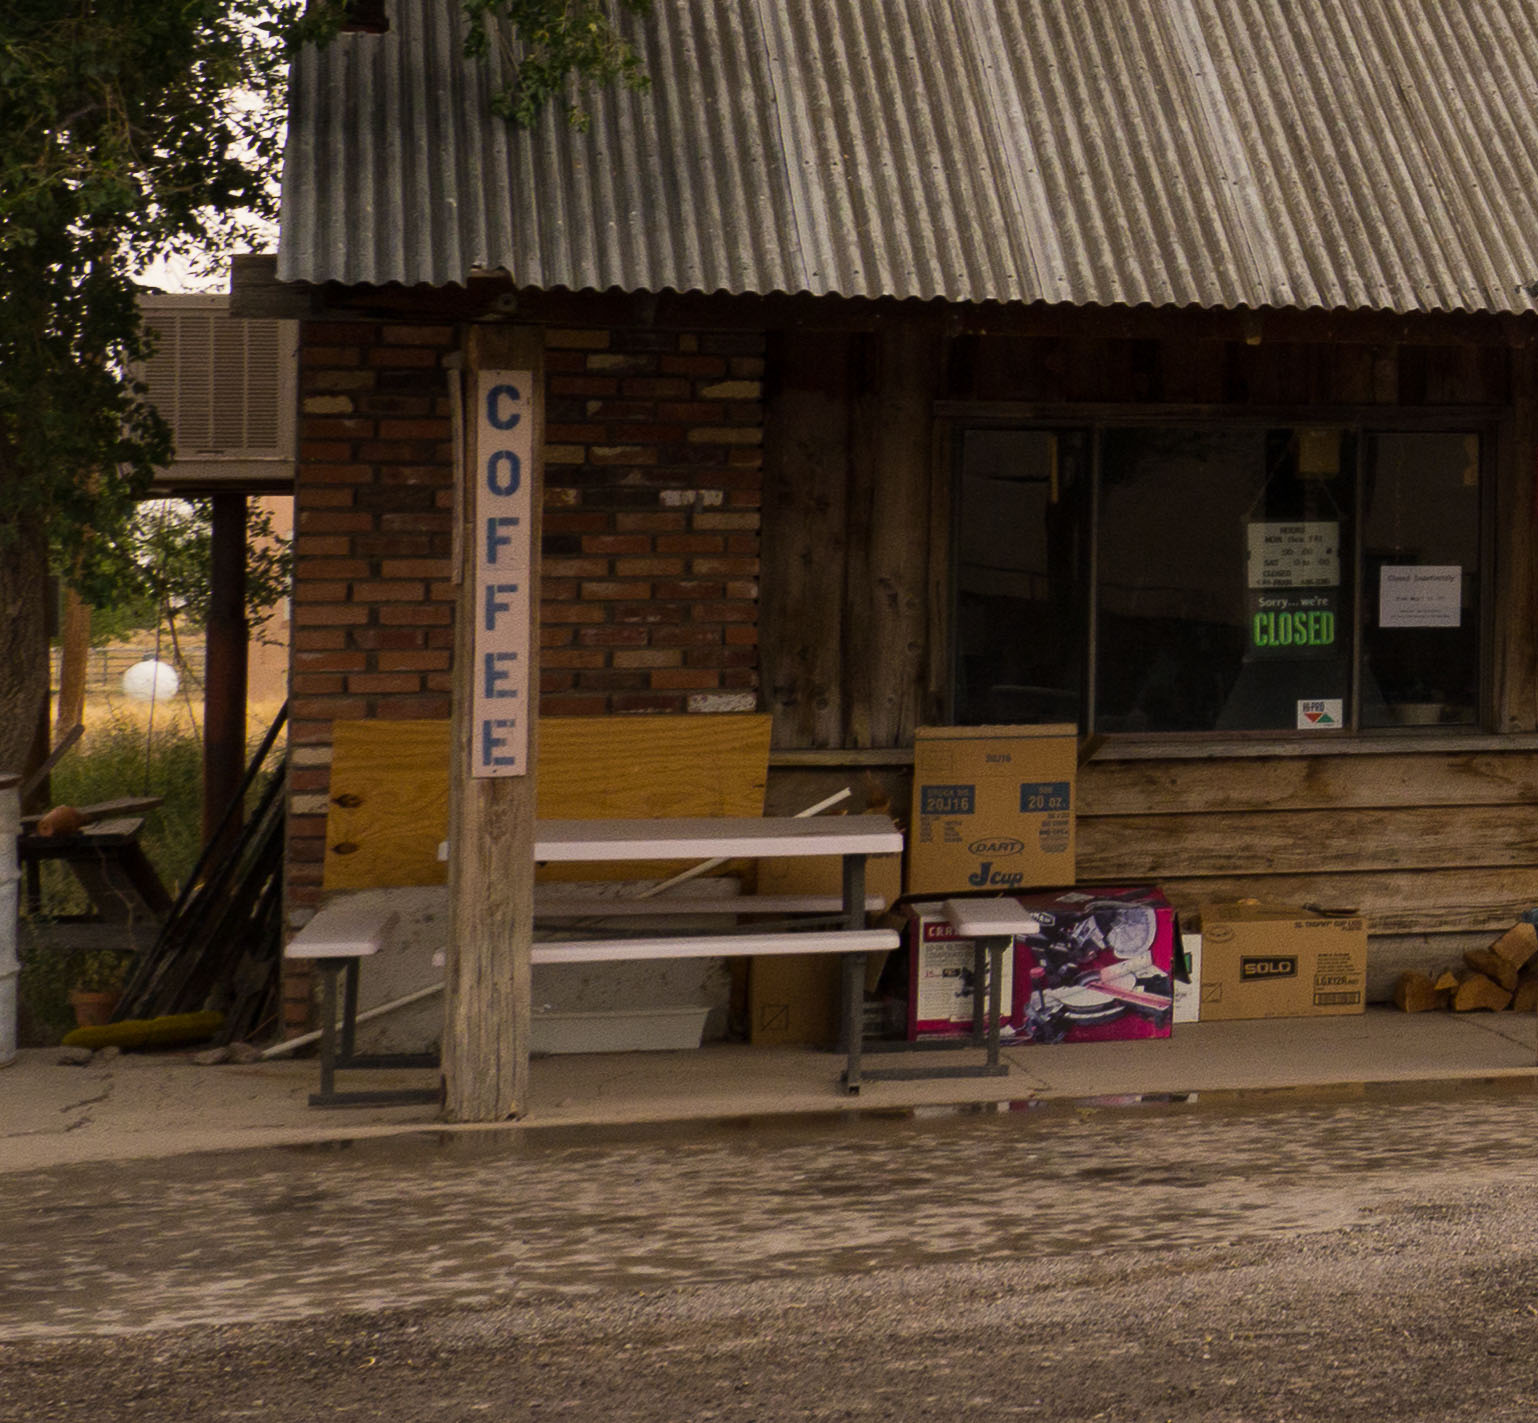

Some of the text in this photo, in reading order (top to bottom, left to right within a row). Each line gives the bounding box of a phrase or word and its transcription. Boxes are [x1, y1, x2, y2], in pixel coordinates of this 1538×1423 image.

[482, 384, 523, 768] COFFEE
[1253, 611, 1335, 647] CLOSED
[927, 797, 969, 812] 20J16
[1028, 796, 1045, 809] 20
[975, 841, 1017, 853] DART
[1245, 961, 1293, 975] SOLO
